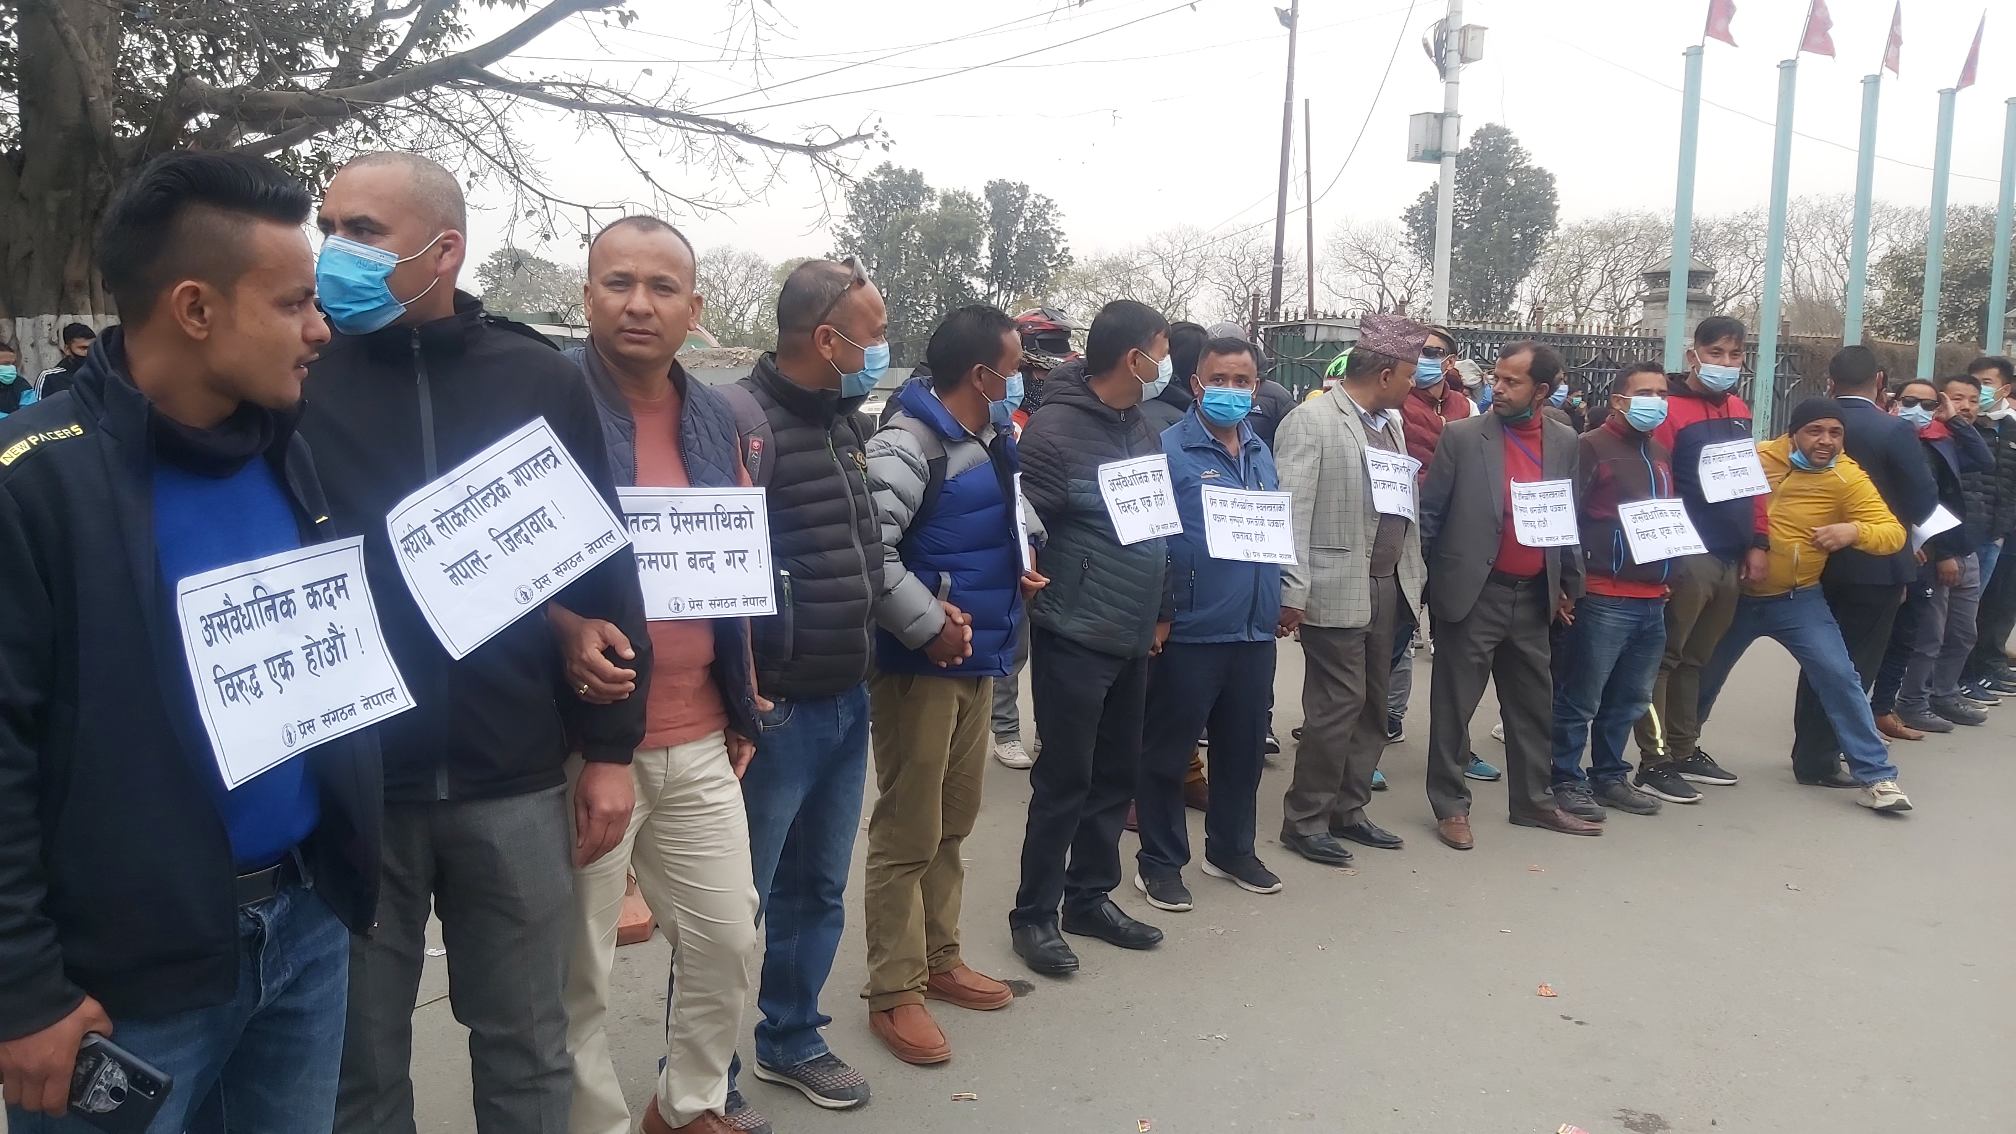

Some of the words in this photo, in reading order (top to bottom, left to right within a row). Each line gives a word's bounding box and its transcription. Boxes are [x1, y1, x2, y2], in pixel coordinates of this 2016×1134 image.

[2, 440, 30, 463] NEW
[28, 424, 84, 446] PACERS
[430, 485, 512, 540] लोकतान्त्रिक
[507, 446, 563, 488] गणतन्त्र
[669, 504, 755, 535] प्रेसमाथिको
[531, 573, 552, 592] प्रेस
[552, 550, 585, 578] संगठन
[584, 529, 617, 555] नेपाल
[686, 551, 717, 574] बन्द
[724, 549, 749, 573] गर
[199, 585, 297, 648] असवैधानिक
[302, 573, 351, 611] कदम
[688, 597, 704, 612] प्रेस
[742, 595, 768, 609] नेपाल
[212, 664, 264, 708] विरुद्ध
[264, 650, 295, 695] एक
[301, 621, 349, 677] होऔं
[297, 718, 317, 739] प्रेस
[320, 703, 357, 728] संगठन
[360, 686, 398, 711] नेपाल
